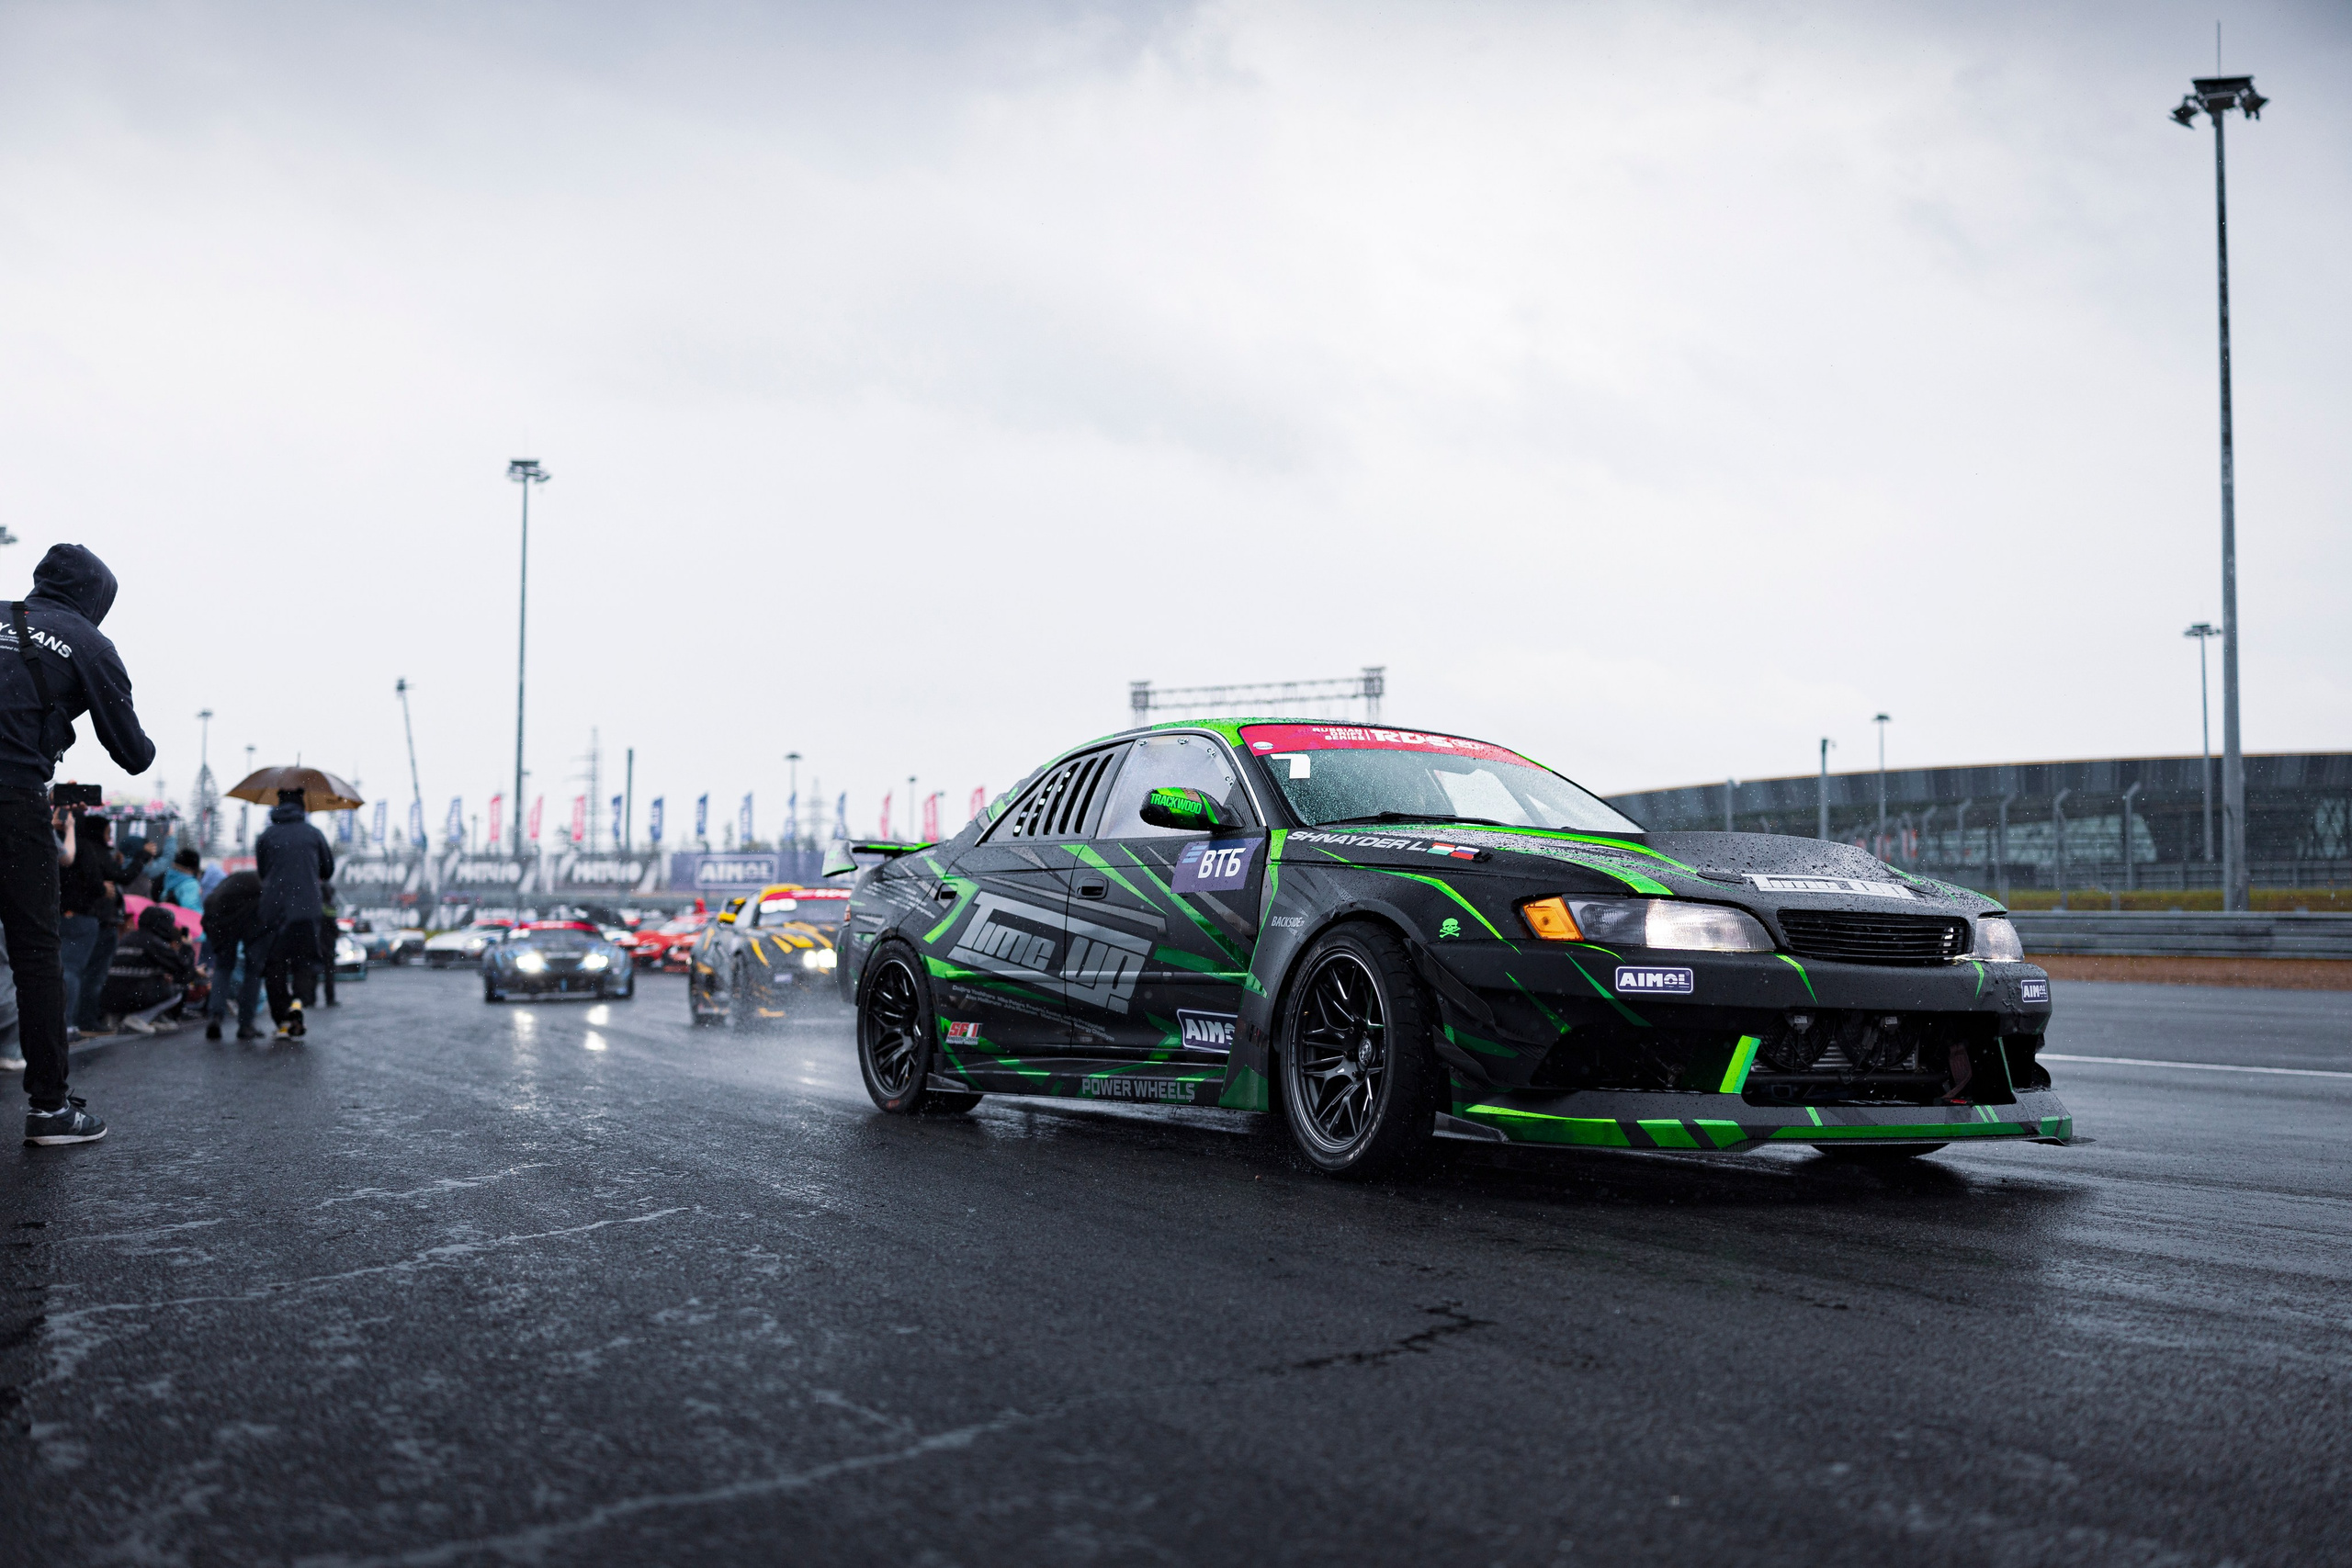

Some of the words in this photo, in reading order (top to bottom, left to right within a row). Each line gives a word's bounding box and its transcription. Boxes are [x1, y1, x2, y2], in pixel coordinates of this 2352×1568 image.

[1370, 728, 1453, 749] RDS
[1150, 793, 1203, 815] TRACKWOOD
[1287, 830, 1407, 850] SHNAYDER
[1406, 840, 1428, 852] L.
[1197, 847, 1247, 879] ВТБ
[1271, 916, 1302, 928] BACKSIDE
[1619, 972, 1690, 988] AIMOL
[1185, 1019, 1236, 1044] AIMO
[1081, 1077, 1132, 1097] POWER
[1134, 1080, 1195, 1100] WHEELS
